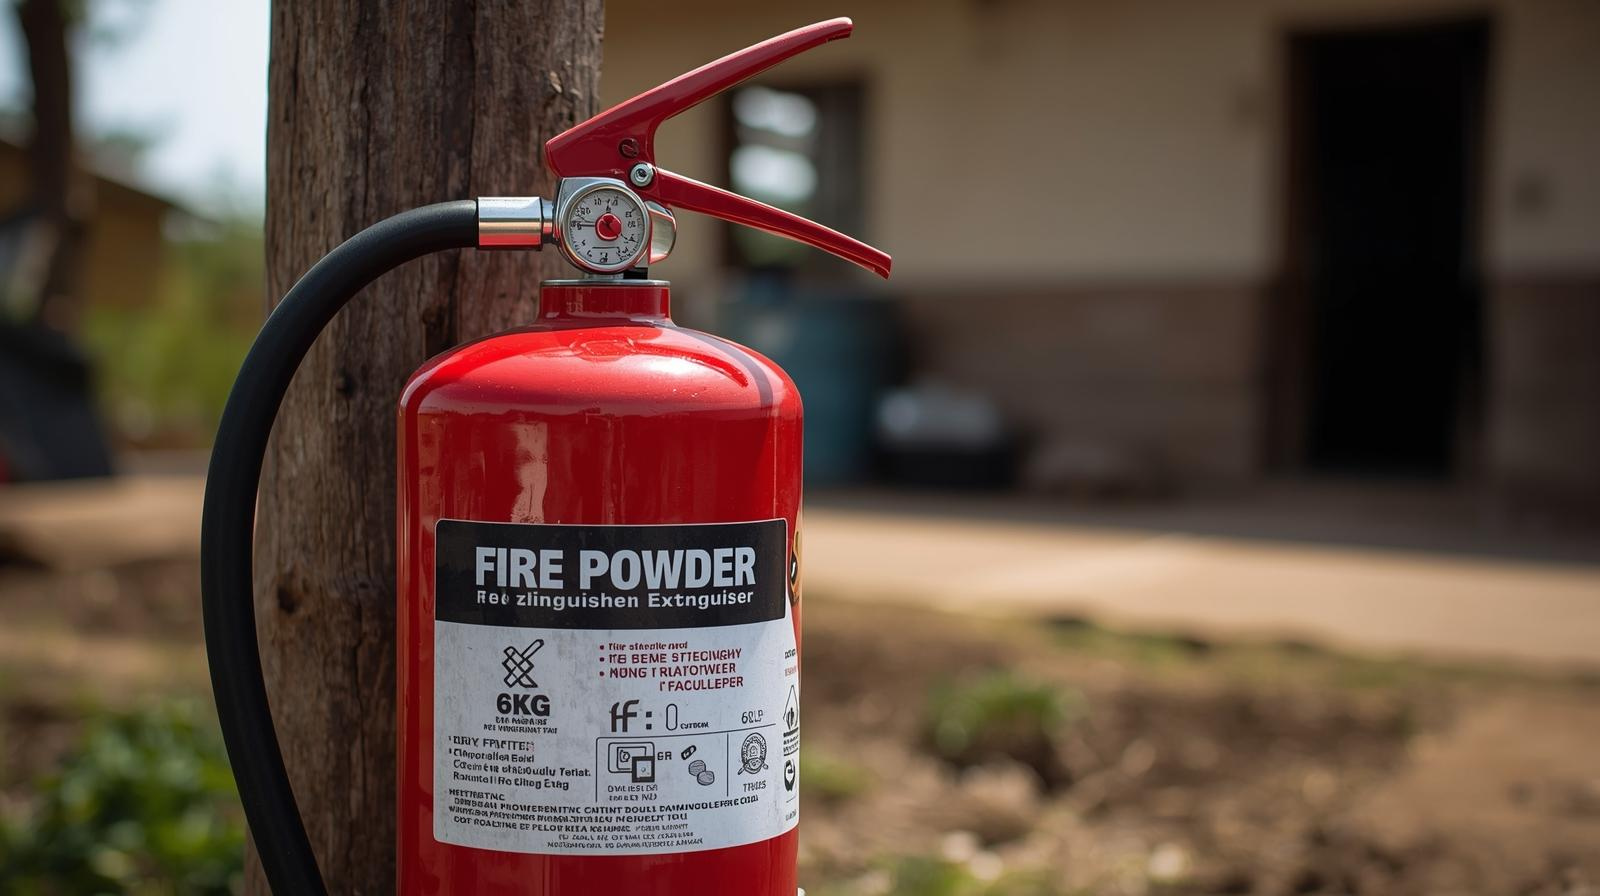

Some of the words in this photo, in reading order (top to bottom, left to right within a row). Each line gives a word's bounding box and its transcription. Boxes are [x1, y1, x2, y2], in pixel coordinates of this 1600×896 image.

[475, 546, 563, 590] FIRE
[579, 546, 756, 590] POWDER
[496, 692, 550, 716] 6KG
